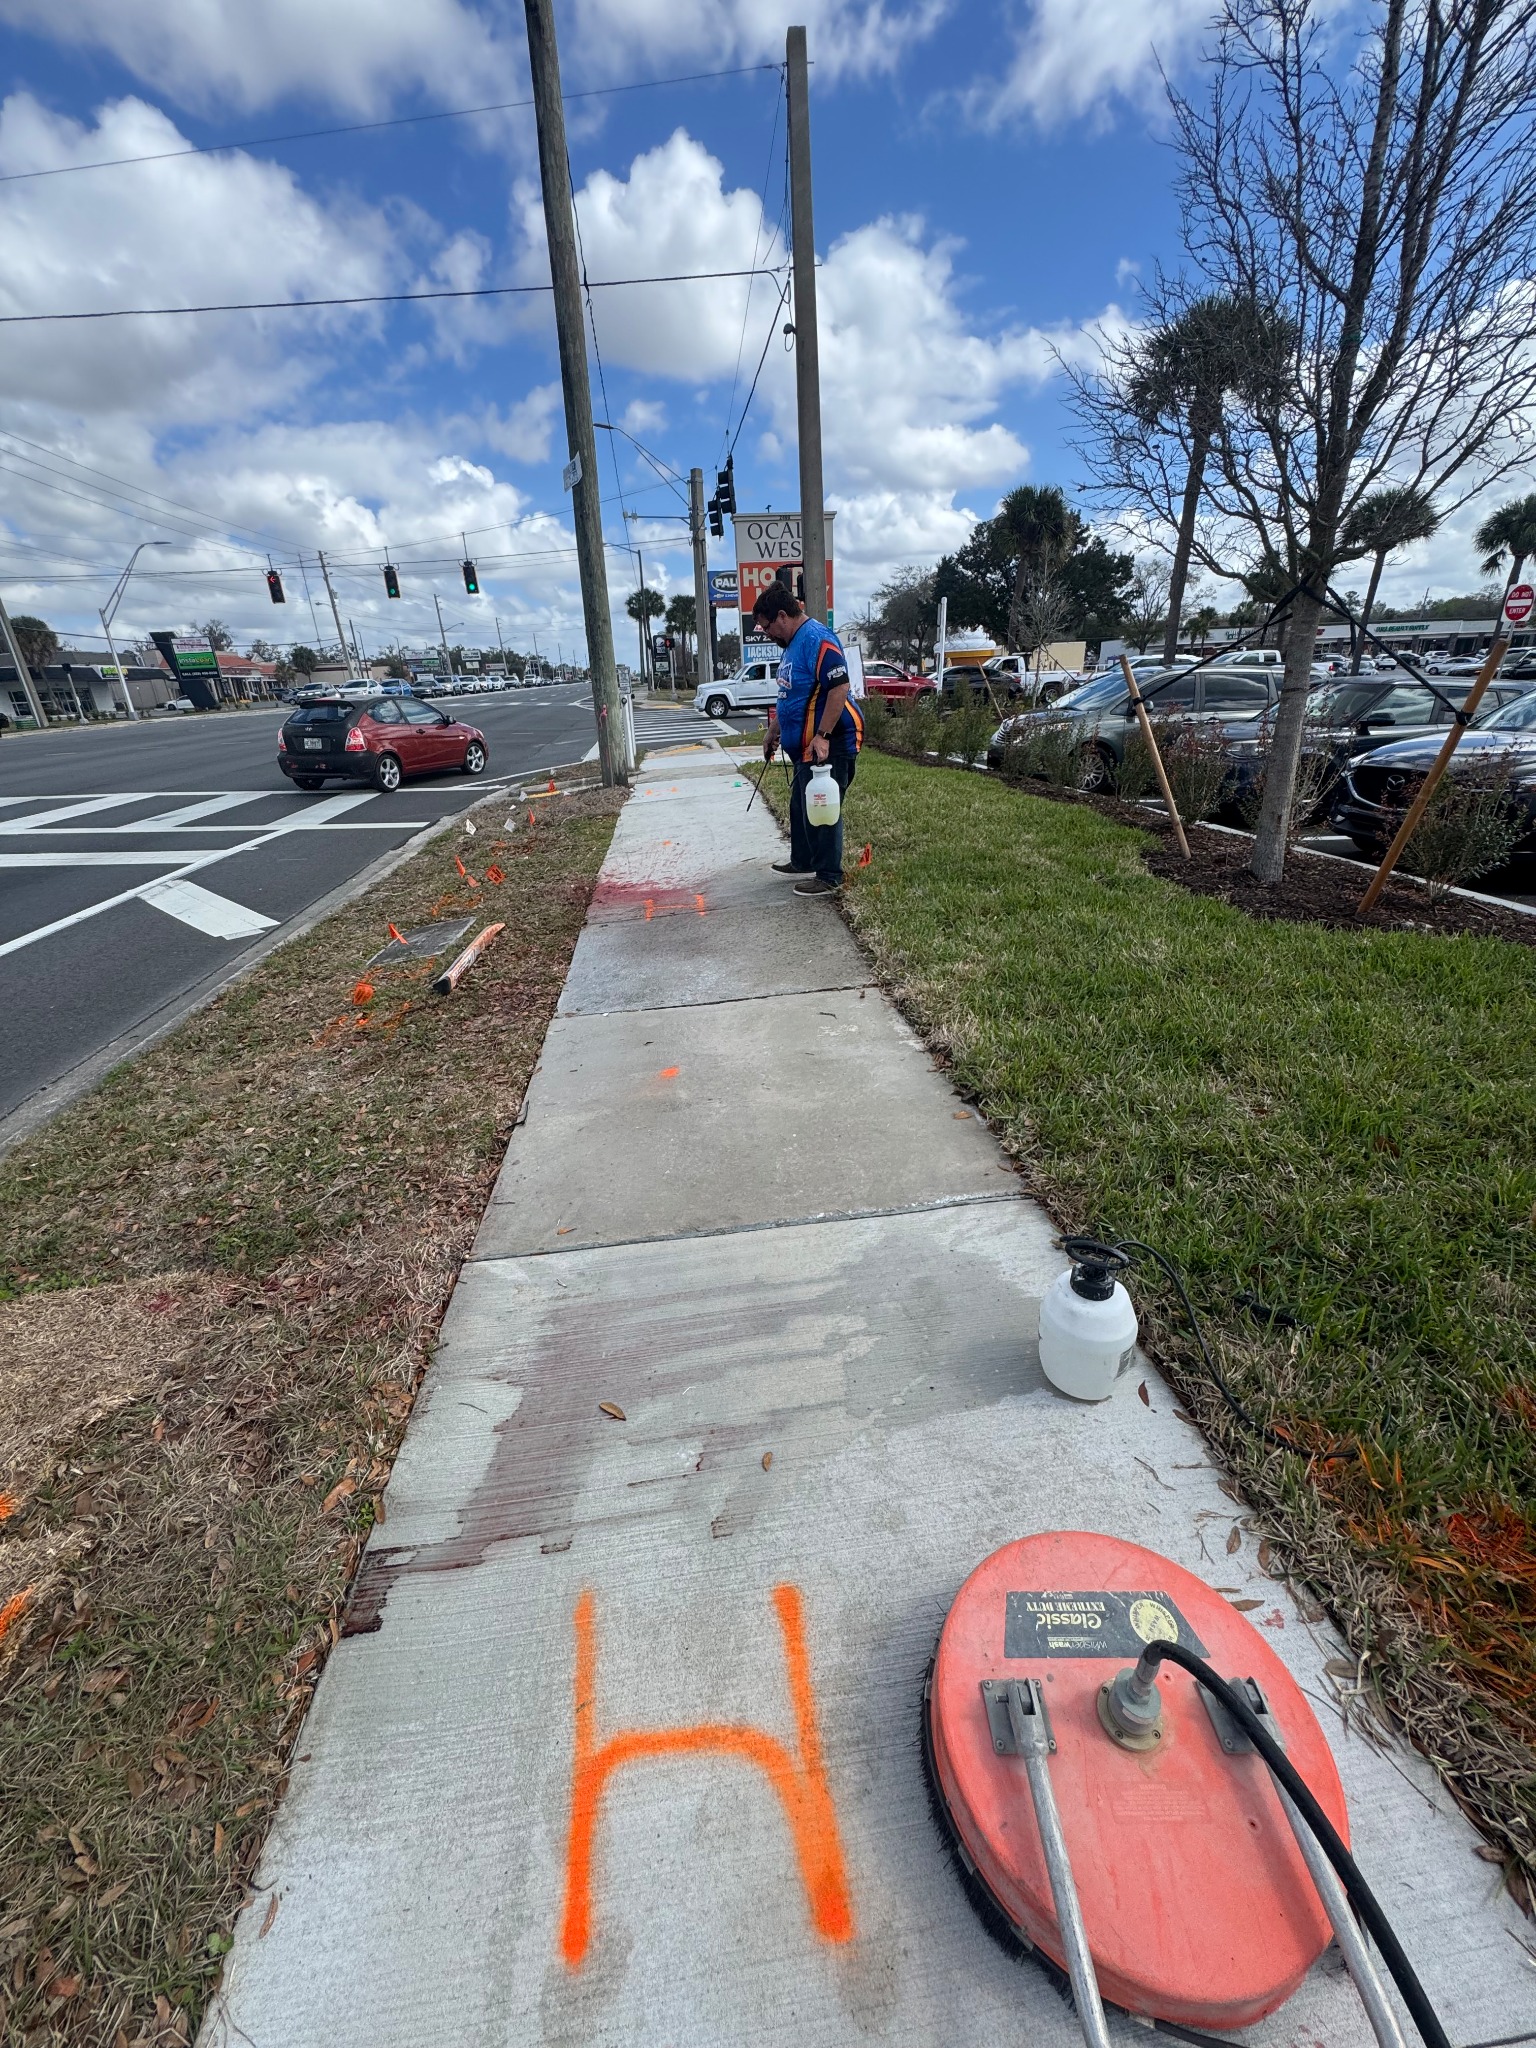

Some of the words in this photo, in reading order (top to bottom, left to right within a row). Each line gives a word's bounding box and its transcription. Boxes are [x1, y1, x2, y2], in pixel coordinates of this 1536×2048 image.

[747, 522, 803, 540] OCAL
[756, 541, 802, 559] WES
[715, 577, 739, 588] PAL
[1026, 1602, 1055, 1612] DUTY
[1056, 1602, 1106, 1612] EXTREME
[1037, 1613, 1102, 1630] Classic
